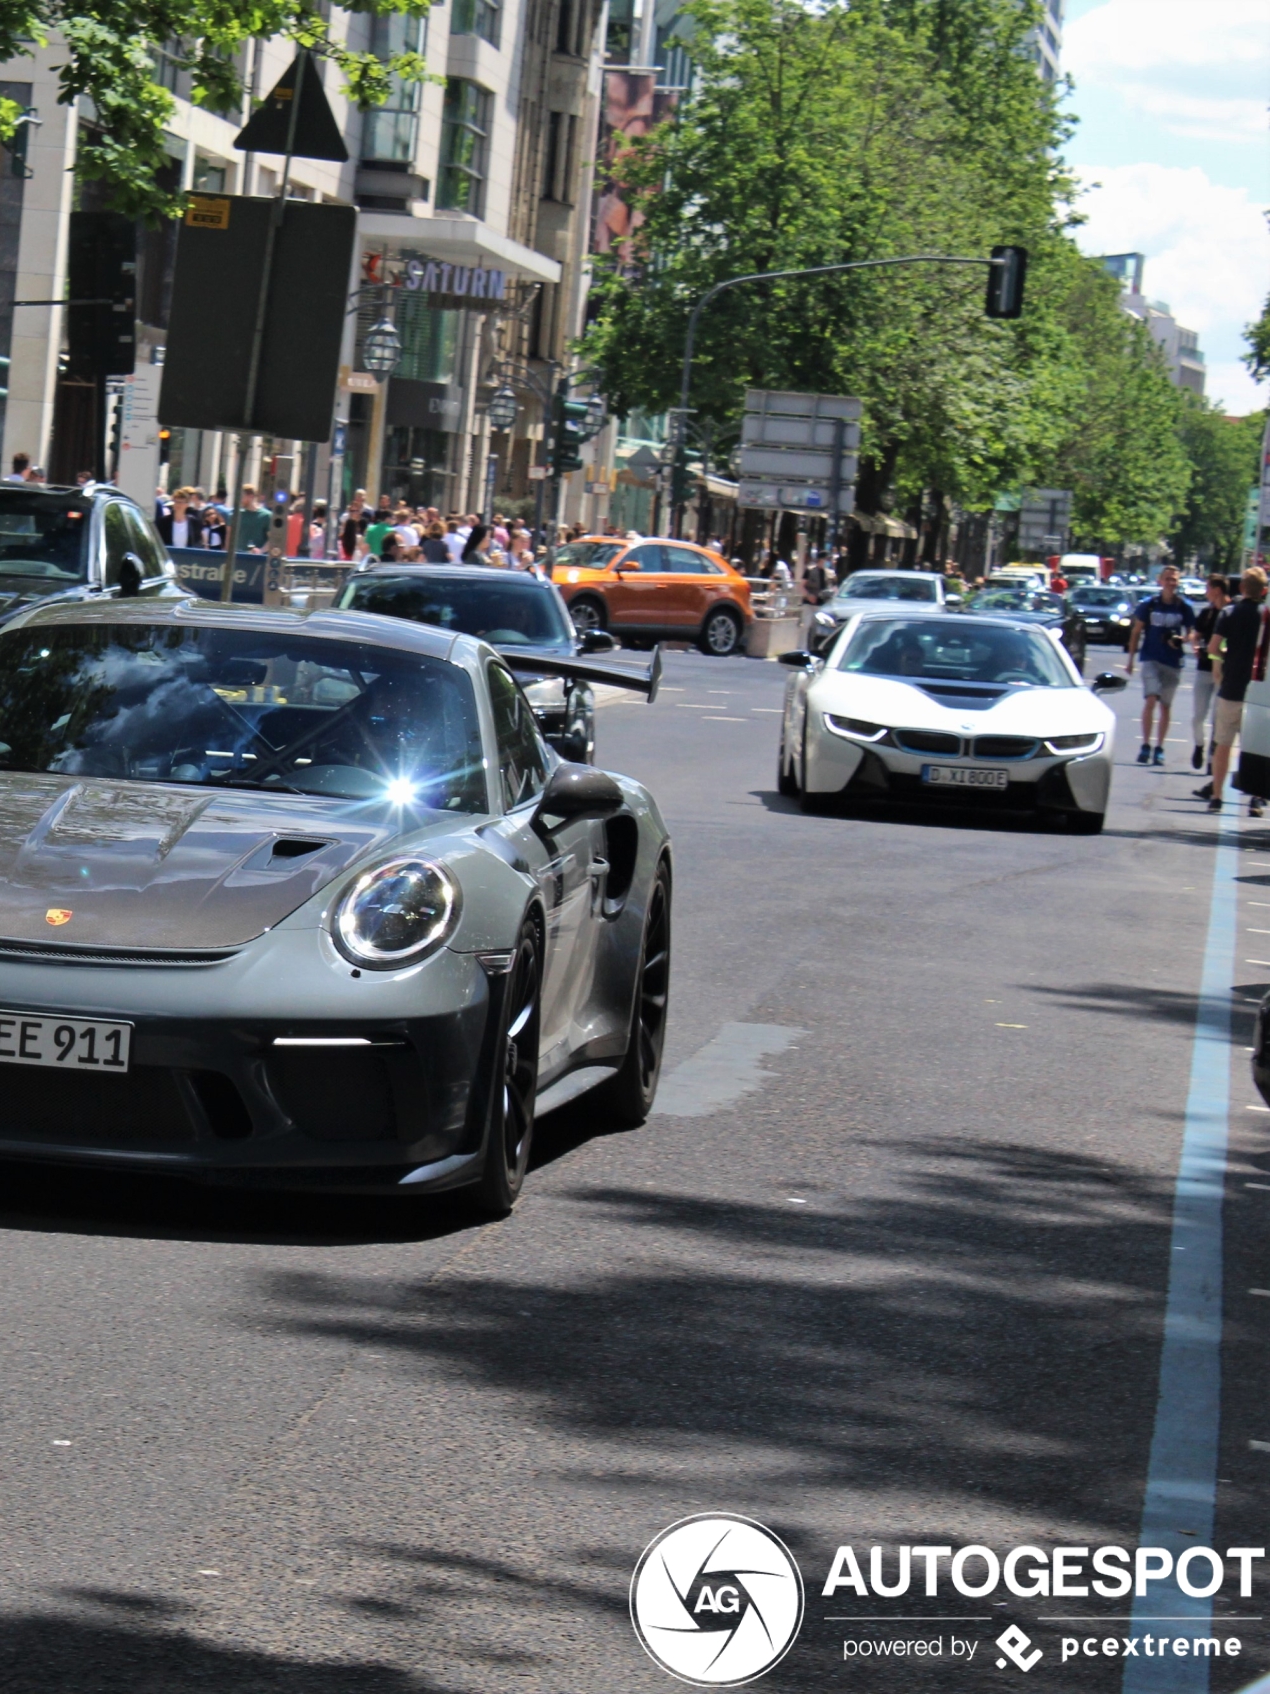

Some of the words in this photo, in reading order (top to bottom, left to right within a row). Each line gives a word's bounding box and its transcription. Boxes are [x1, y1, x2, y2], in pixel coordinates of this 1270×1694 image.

[405, 259, 507, 299] SATURN
[176, 563, 248, 584] strae
[930, 768, 940, 782] D
[53, 1024, 125, 1067] 911
